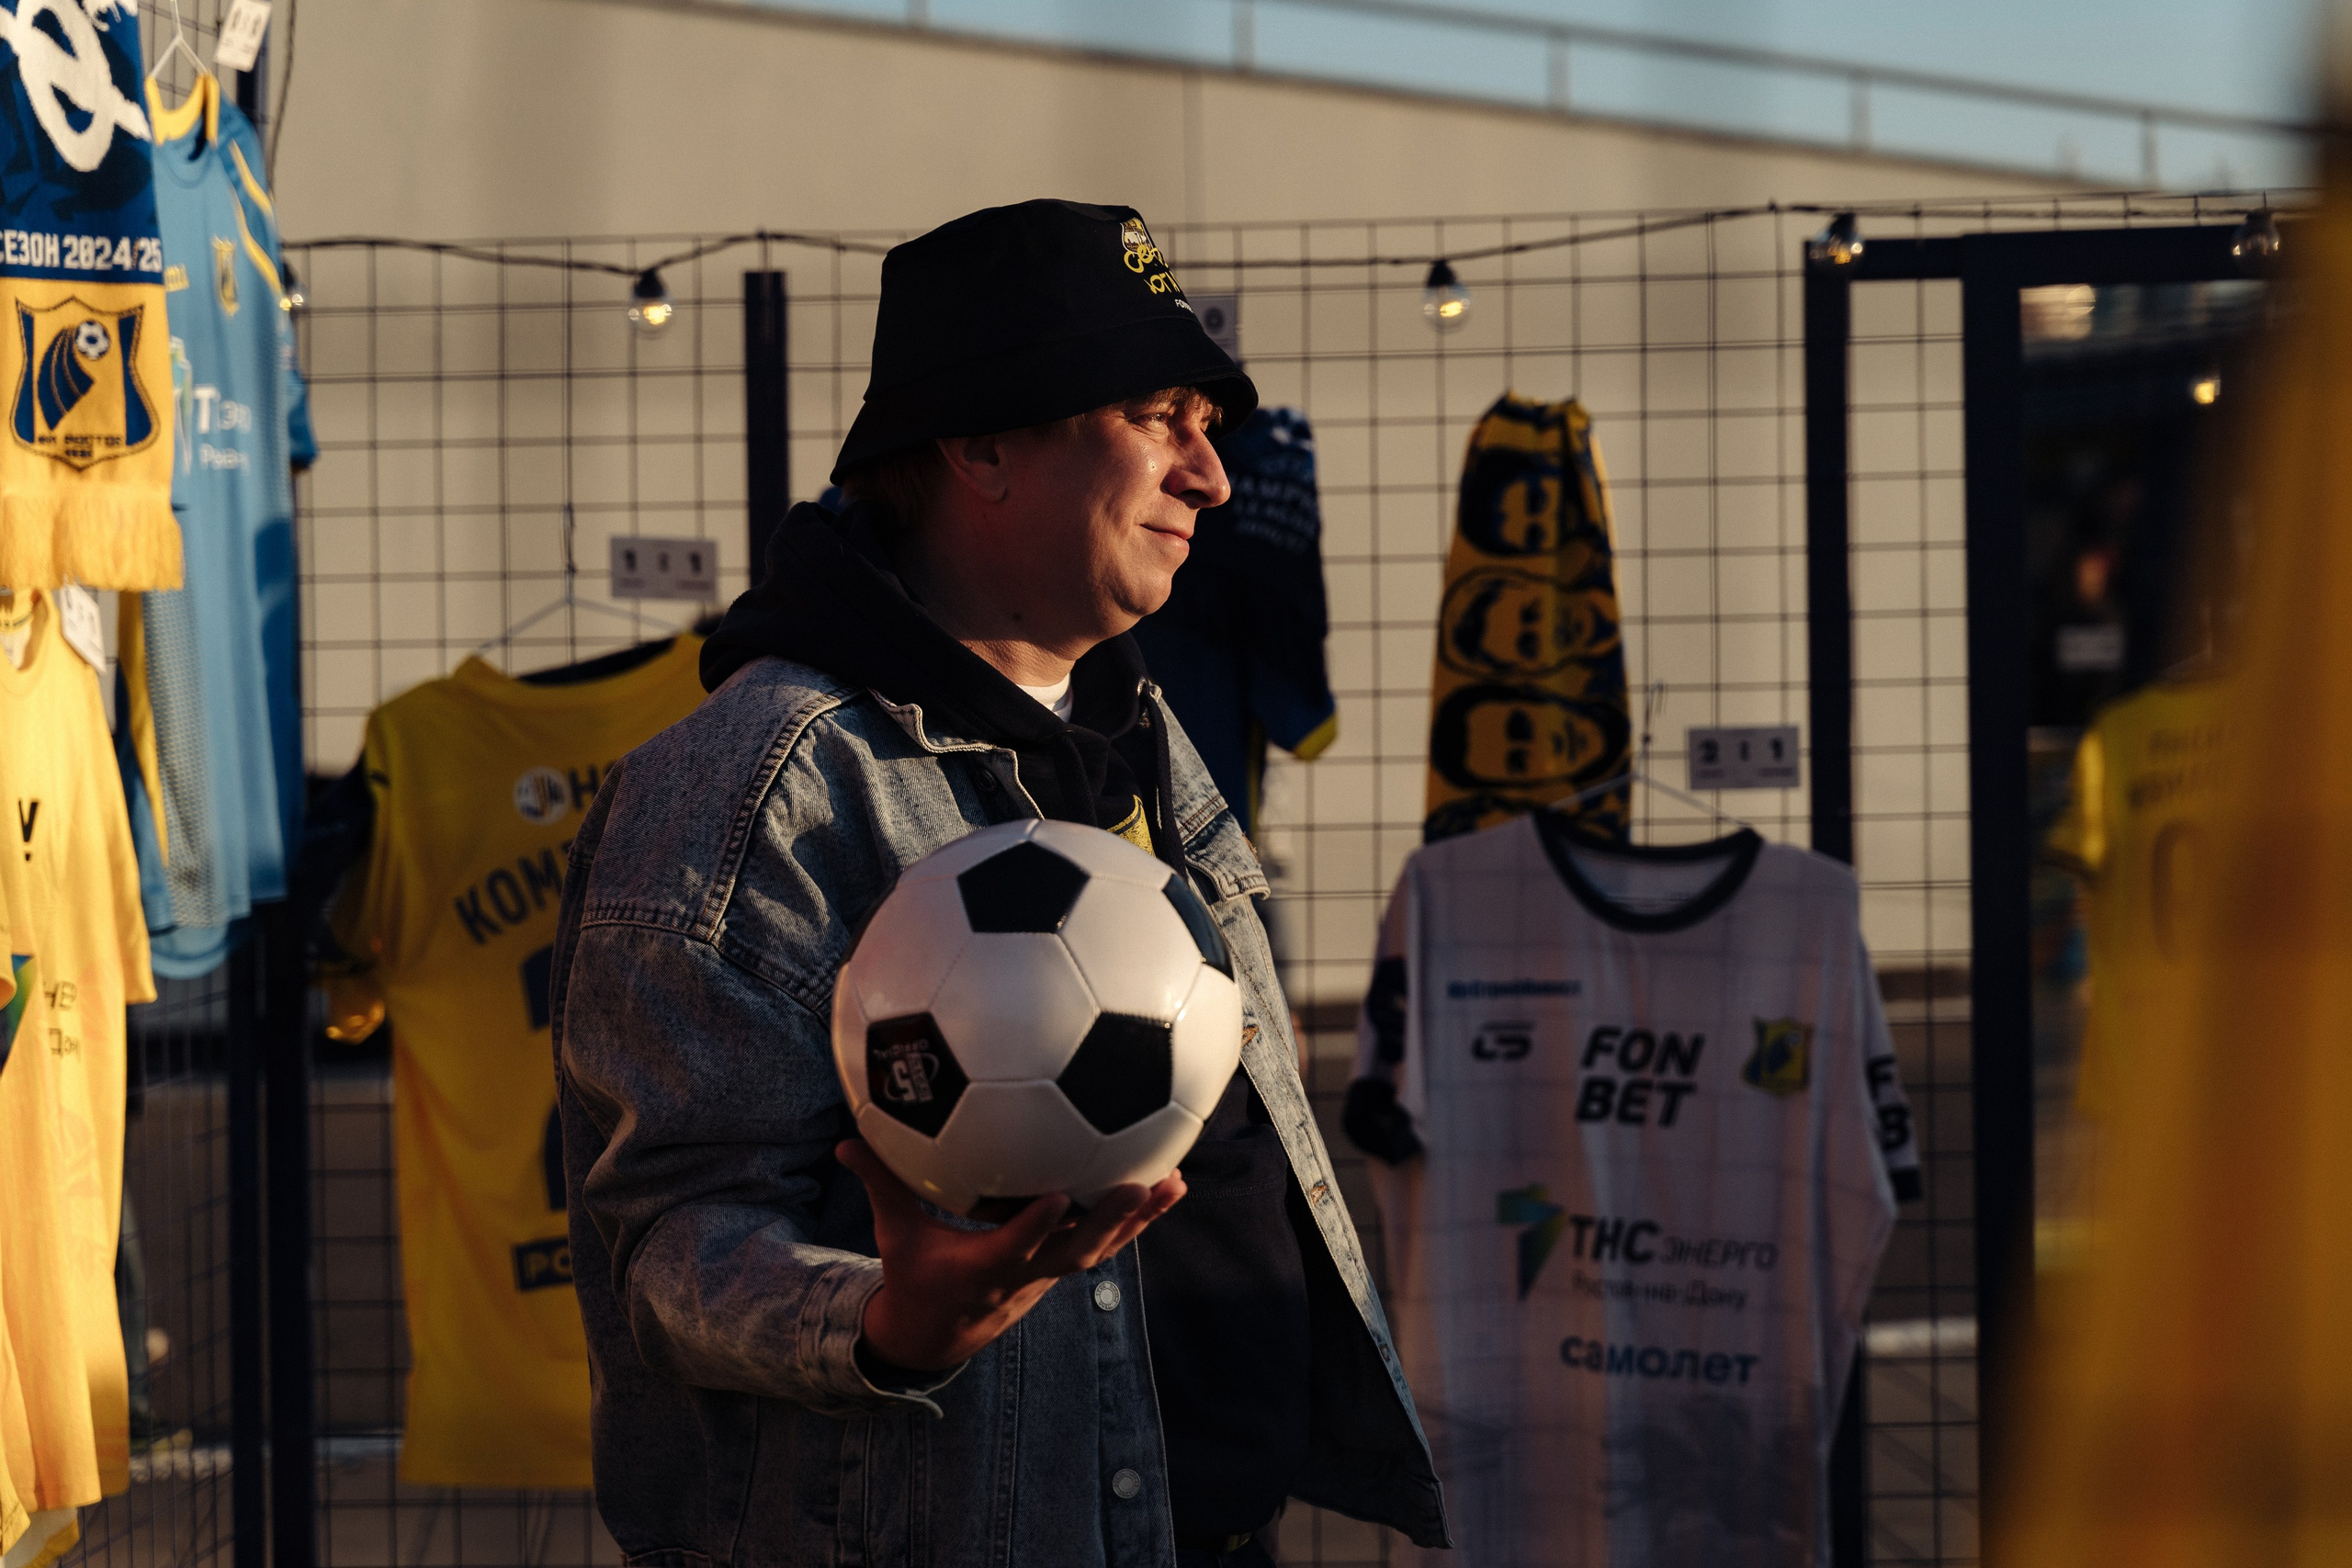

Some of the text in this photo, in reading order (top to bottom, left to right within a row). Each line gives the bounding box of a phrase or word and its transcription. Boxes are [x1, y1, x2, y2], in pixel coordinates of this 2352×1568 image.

[62, 234, 164, 273] 2024/25
[454, 838, 573, 945] КОМ
[1579, 1025, 1706, 1078] FON
[1575, 1075, 1698, 1128] BET
[1567, 1213, 1660, 1265] ТНС
[1559, 1335, 1759, 1386] самолет
